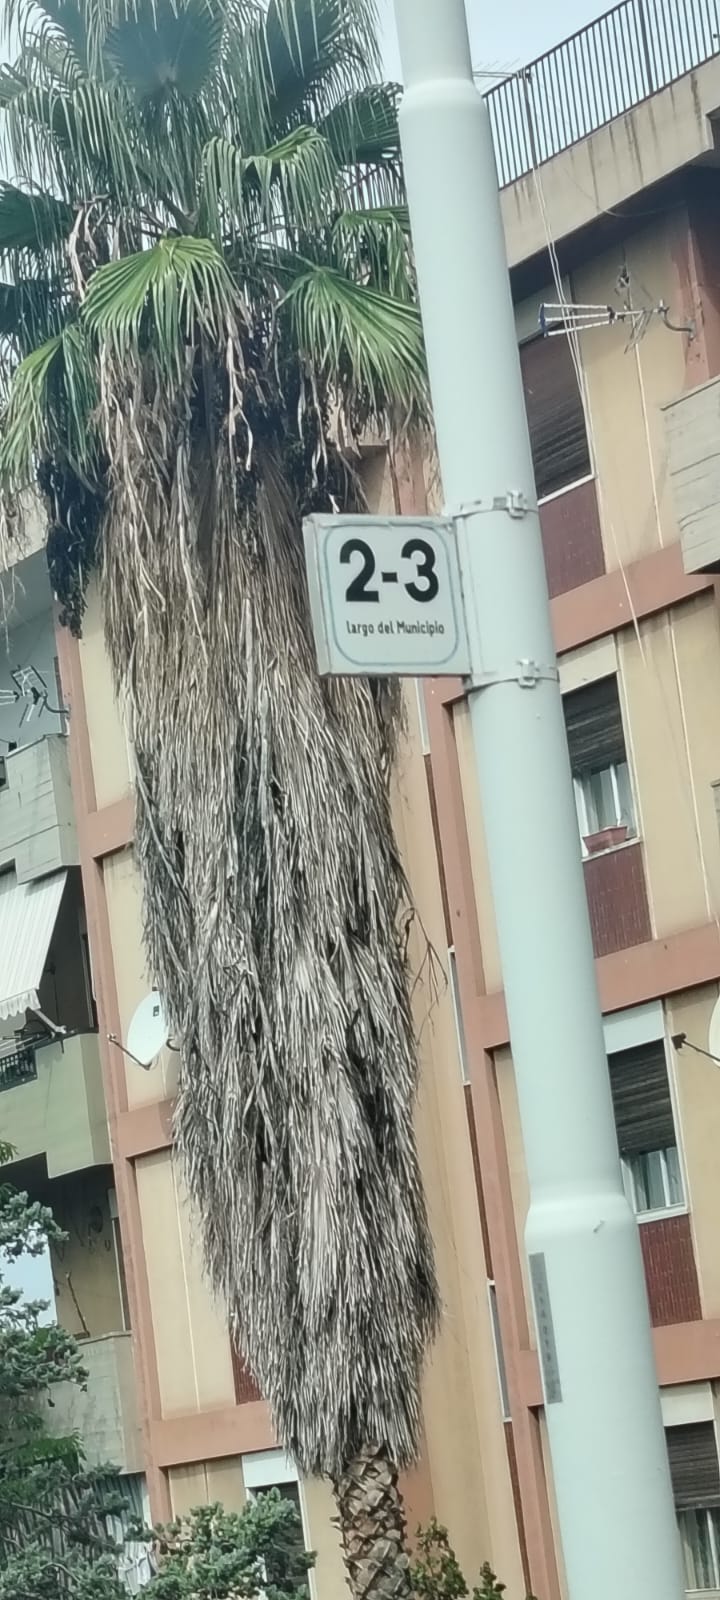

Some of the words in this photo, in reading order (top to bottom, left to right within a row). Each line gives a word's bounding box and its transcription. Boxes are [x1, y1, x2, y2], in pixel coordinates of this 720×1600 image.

[339, 538, 439, 603] 2-3
[346, 620, 374, 637] largo
[378, 621, 394, 634] del
[396, 620, 445, 637] Municipio
